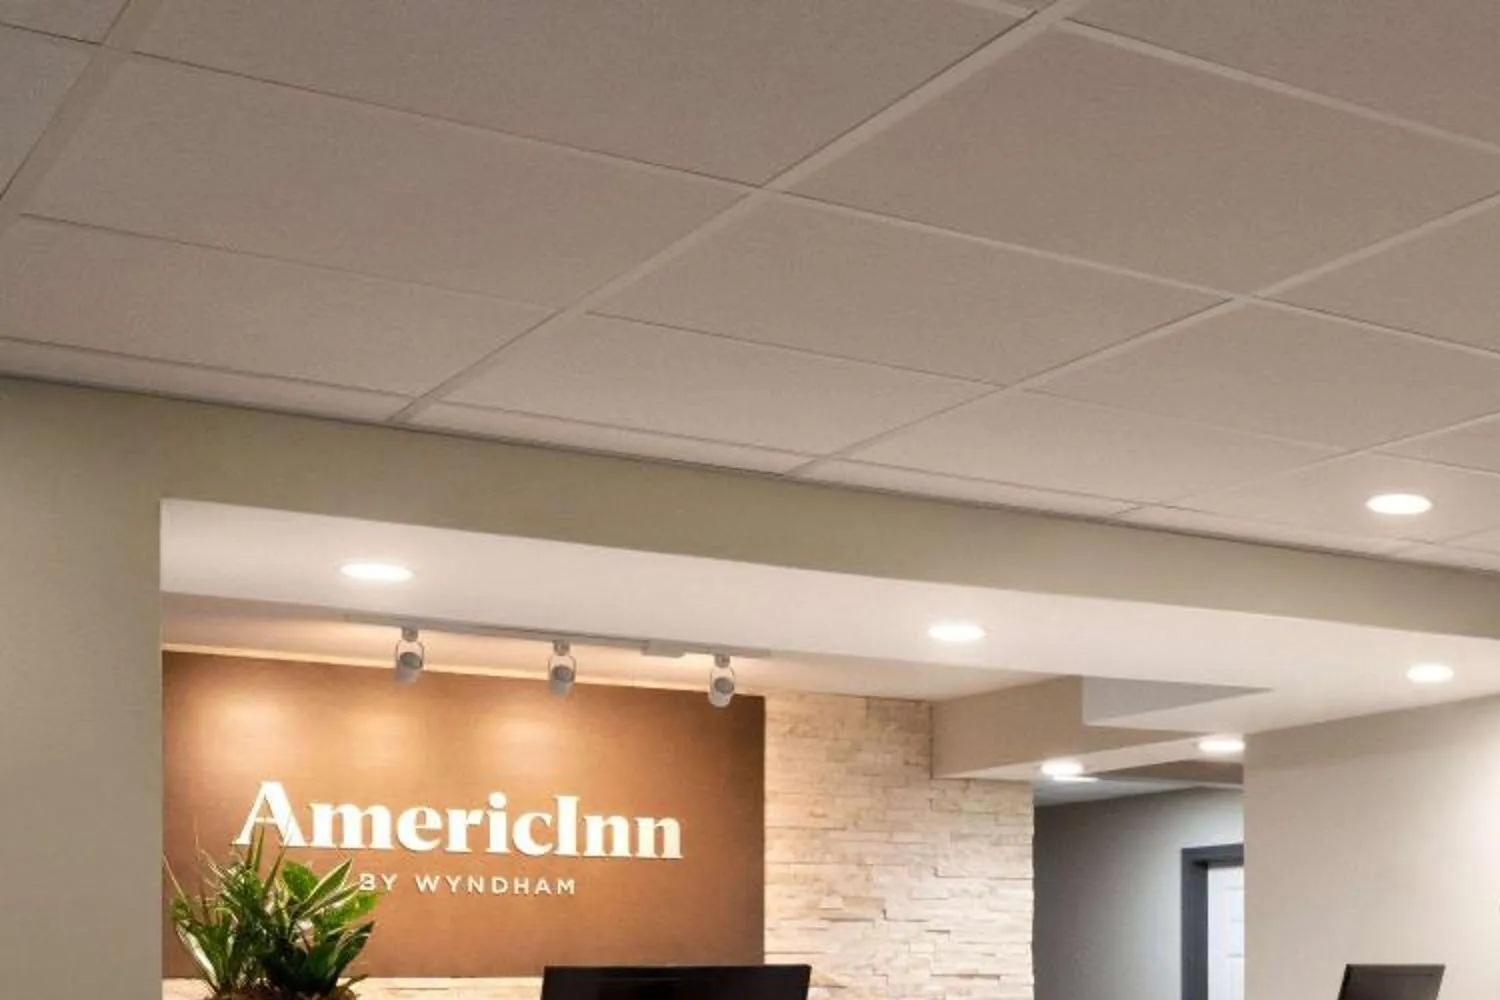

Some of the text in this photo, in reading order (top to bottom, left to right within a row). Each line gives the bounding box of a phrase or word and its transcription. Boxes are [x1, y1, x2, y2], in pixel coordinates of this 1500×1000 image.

[231, 781, 684, 859] AmericInn
[358, 873, 577, 895] BY WYNDHAM
